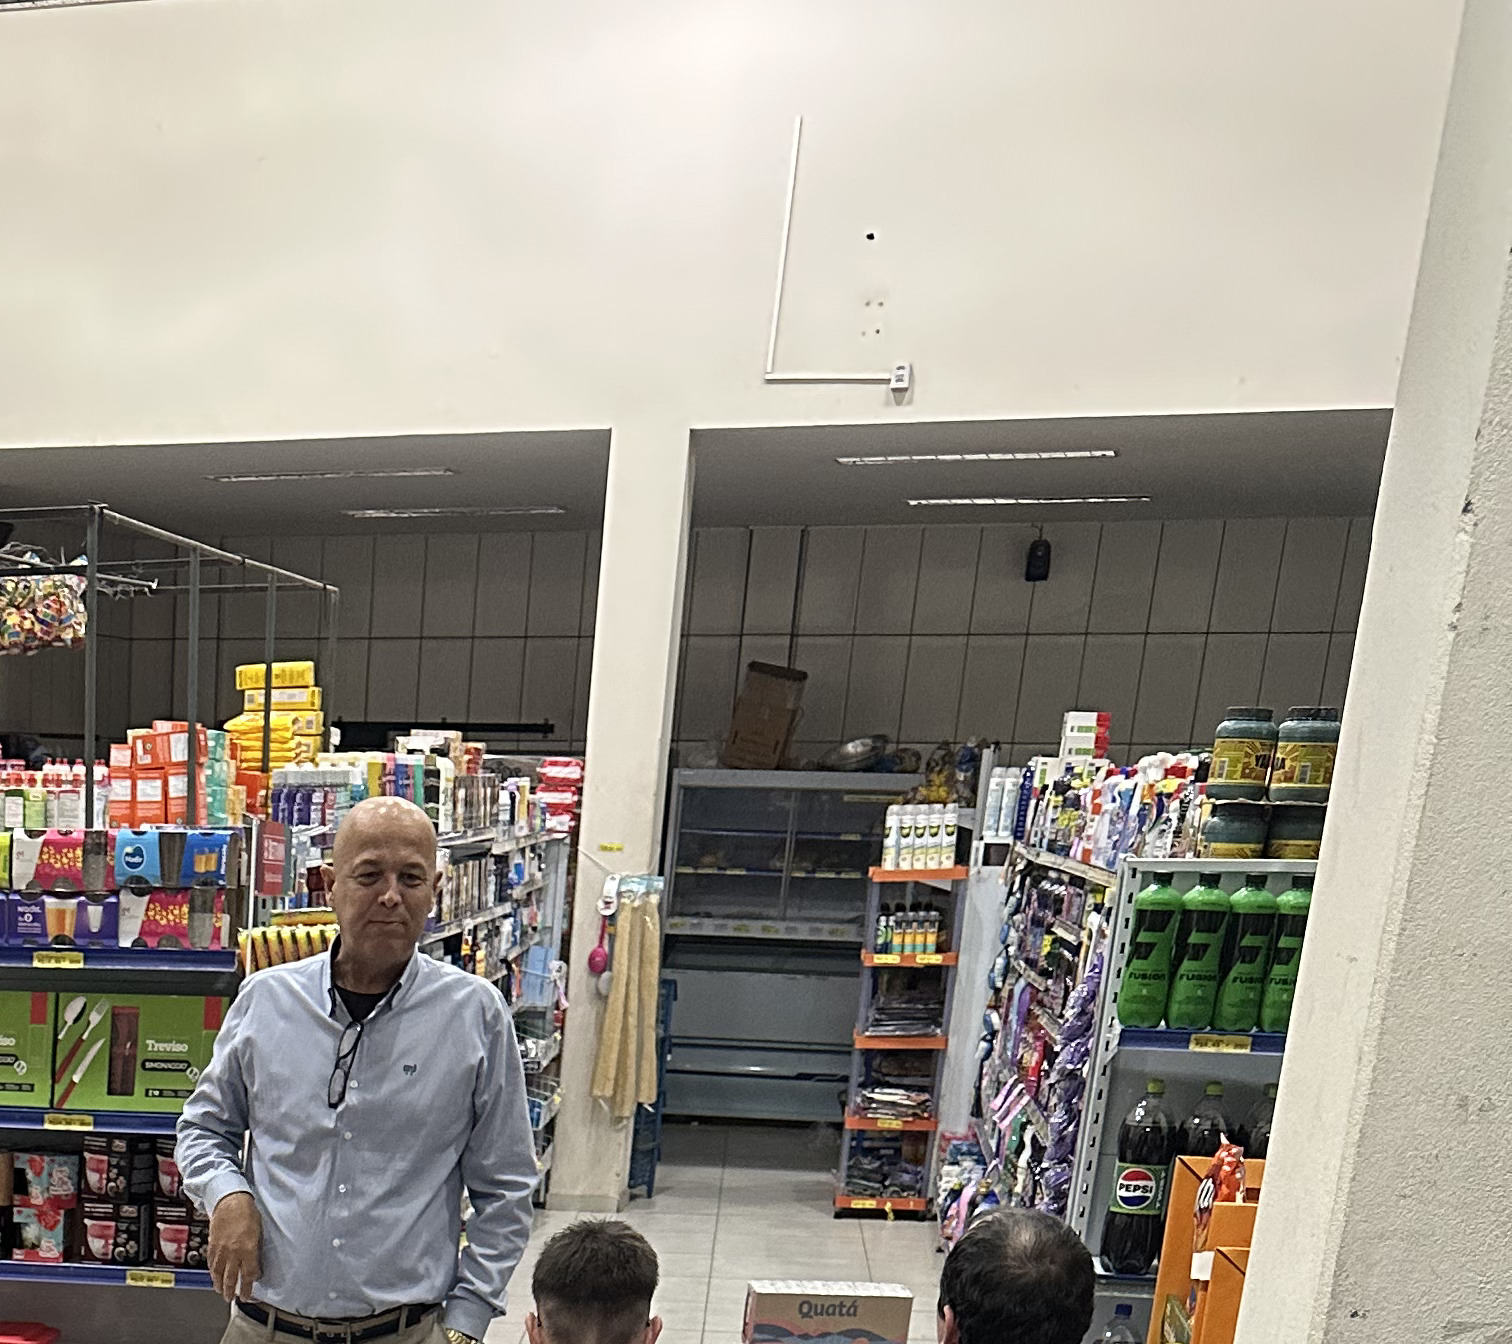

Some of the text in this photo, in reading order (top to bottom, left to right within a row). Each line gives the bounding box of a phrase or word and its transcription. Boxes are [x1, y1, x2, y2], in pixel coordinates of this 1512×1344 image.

[145, 1040, 189, 1052] Treviso
[1118, 1182, 1154, 1194] PEPSI
[797, 1300, 860, 1319] Quatá
